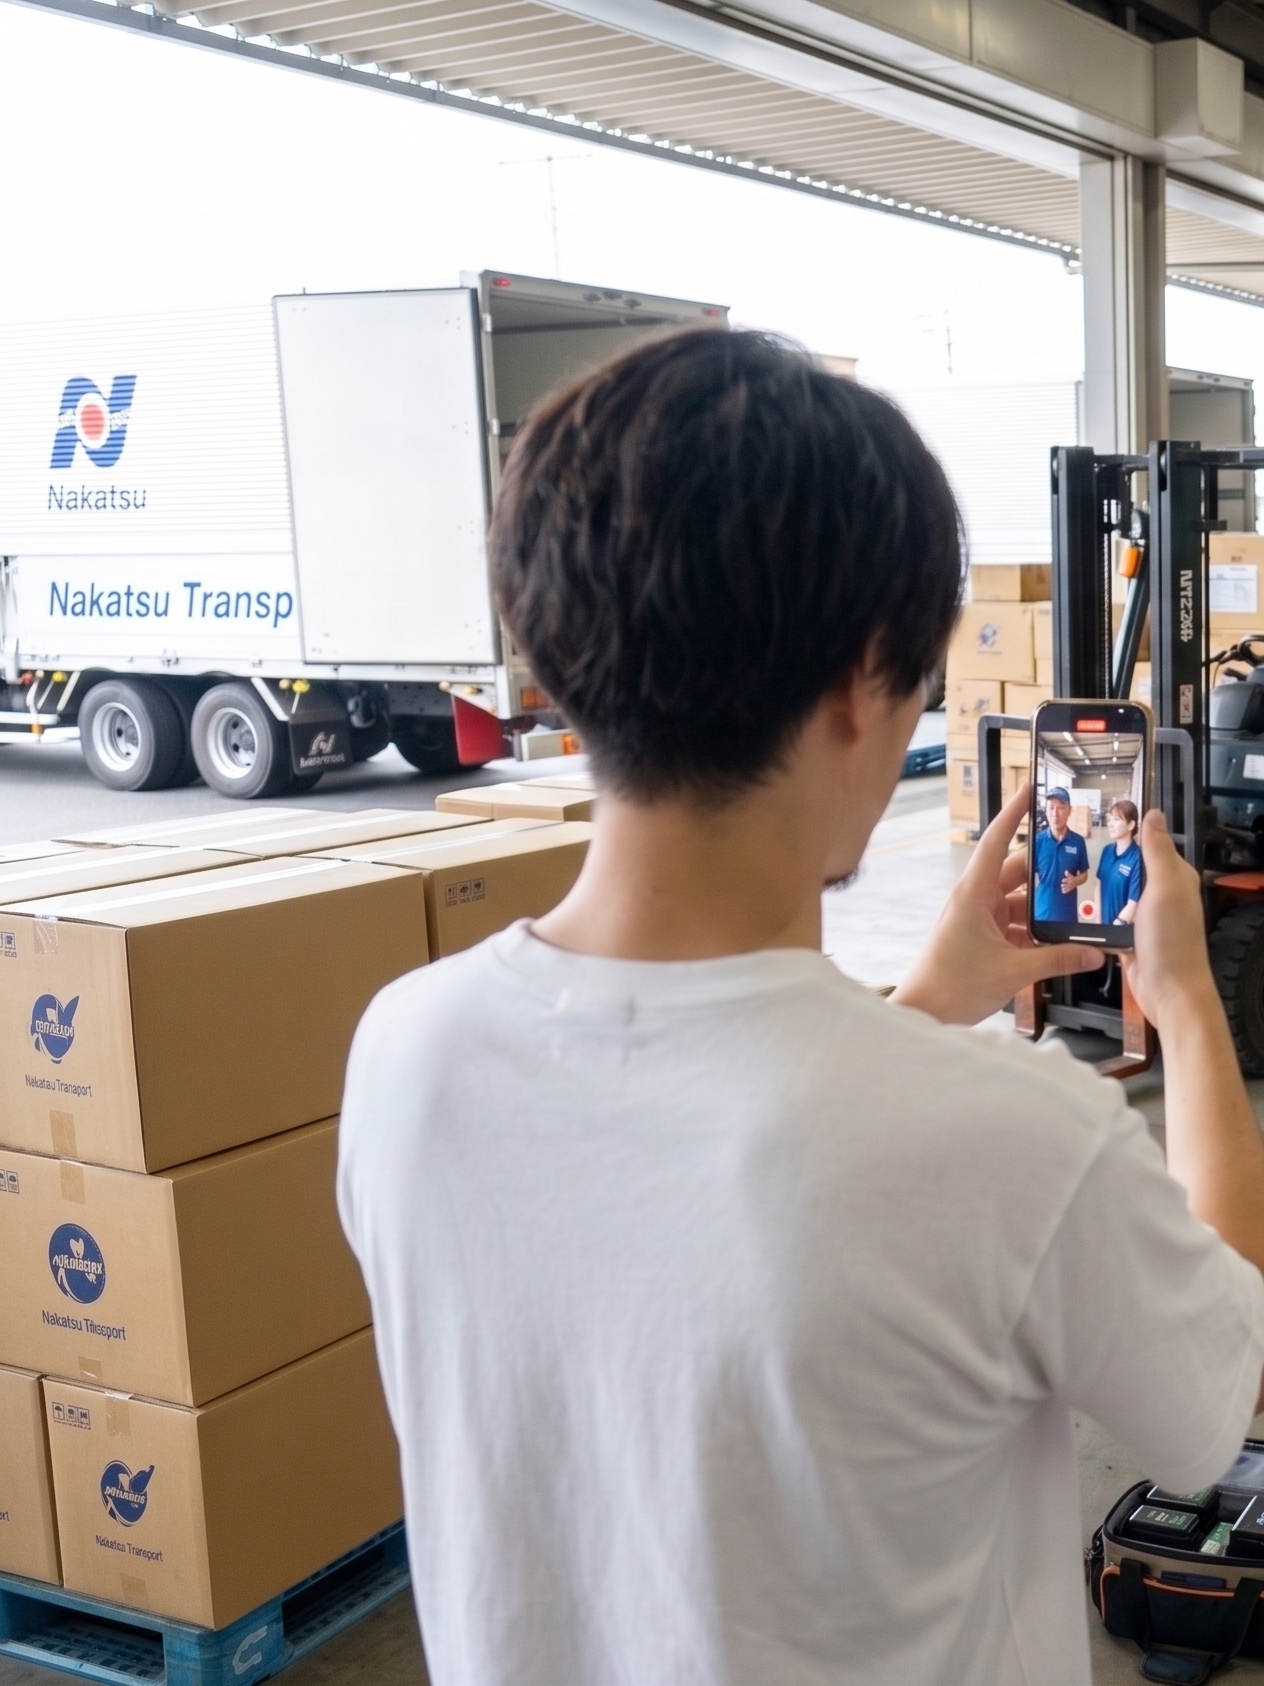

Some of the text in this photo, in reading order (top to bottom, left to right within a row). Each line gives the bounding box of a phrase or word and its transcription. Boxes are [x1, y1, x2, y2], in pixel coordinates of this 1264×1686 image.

[48, 484, 147, 511] Nakatsu
[49, 581, 294, 628] Nakatsu Transp
[41, 1309, 83, 1331] Nakatsu
